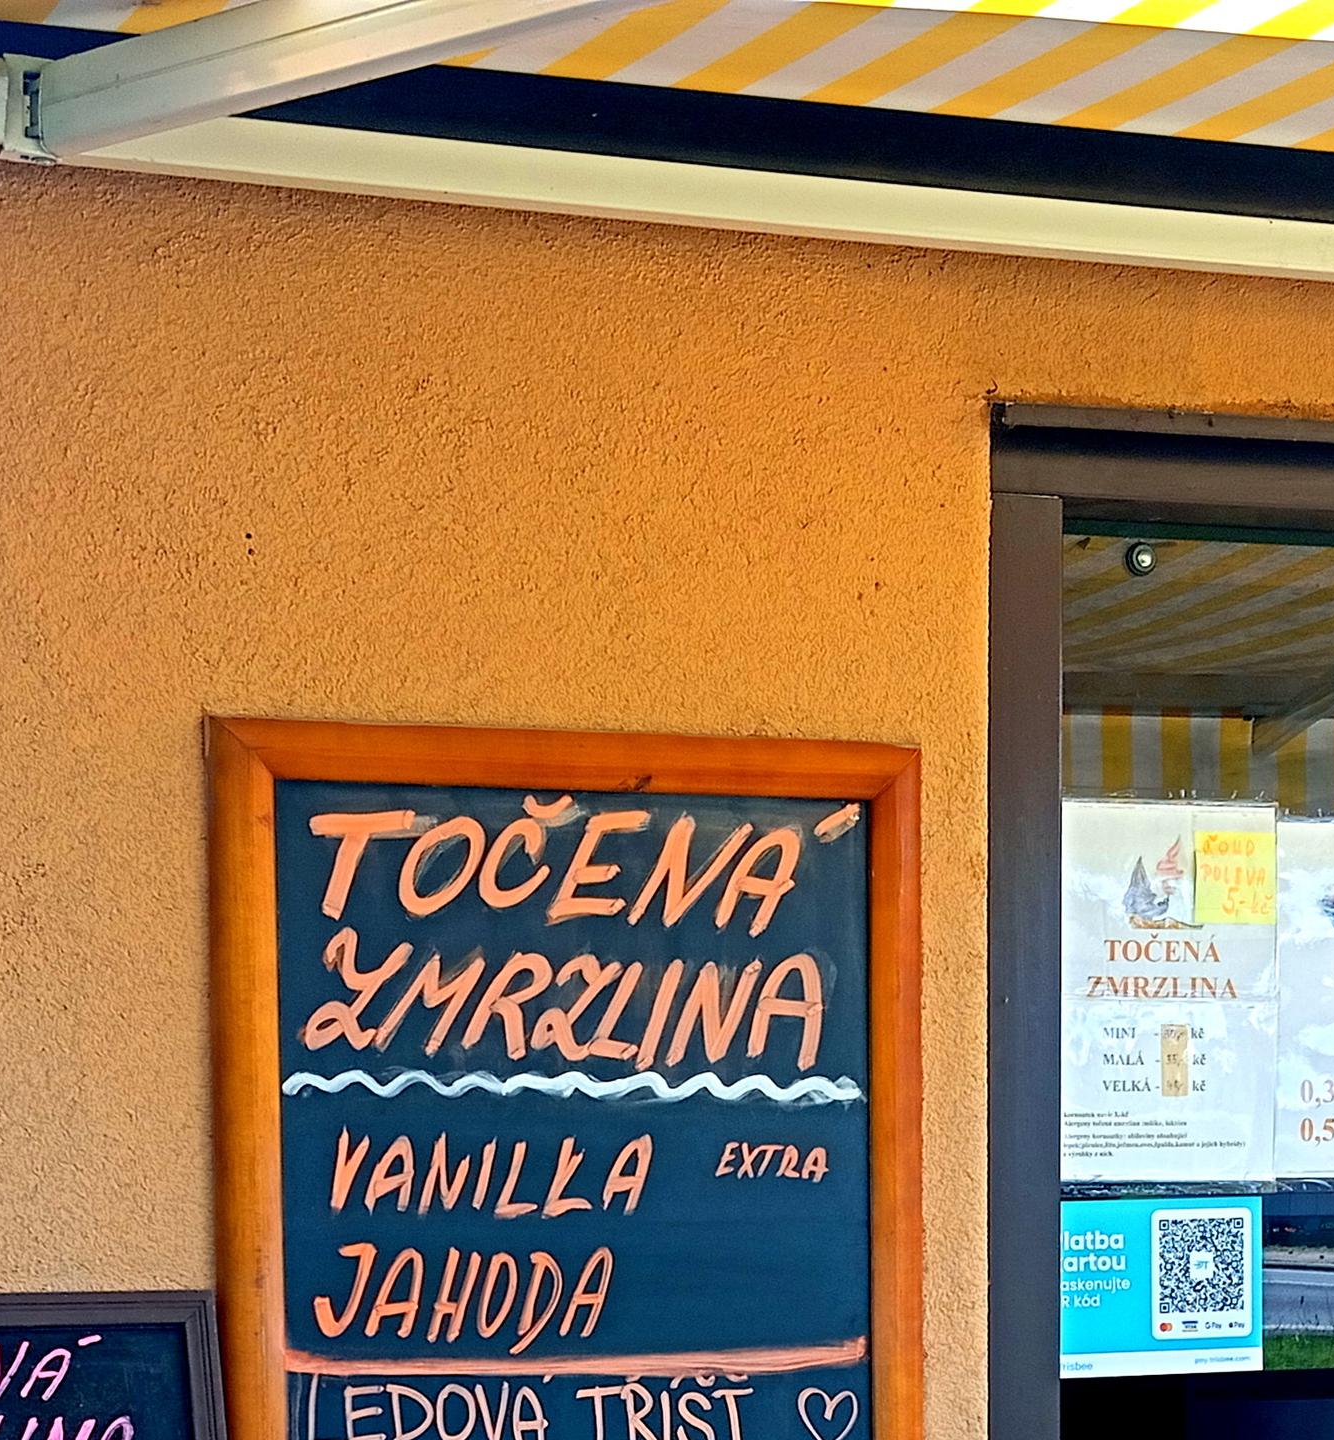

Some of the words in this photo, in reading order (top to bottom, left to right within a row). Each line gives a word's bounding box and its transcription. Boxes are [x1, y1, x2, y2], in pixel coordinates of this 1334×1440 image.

[309, 795, 861, 937] TOČENÁ
[1104, 933, 1221, 963] TOČENÁ
[297, 926, 830, 1071] ZMRZLINA
[1087, 976, 1238, 999] ZMRZLINA
[1103, 1027, 1135, 1039] MINI
[1191, 1026, 1205, 1039] kč
[1103, 1051, 1144, 1065] MALÁ
[1193, 1053, 1207, 1066] kč
[1103, 1077, 1151, 1092] VELKÁ
[1193, 1079, 1207, 1092] kč
[1300, 1079, 1334, 1108] 0,3
[715, 1140, 828, 1183] EXTRA
[1060, 1230, 1125, 1251] latba
[1060, 1252, 1127, 1272] artou
[314, 1242, 614, 1355] JAHODA
[1073, 1293, 1101, 1308] kód
[1061, 1362, 1093, 1371] risbee
